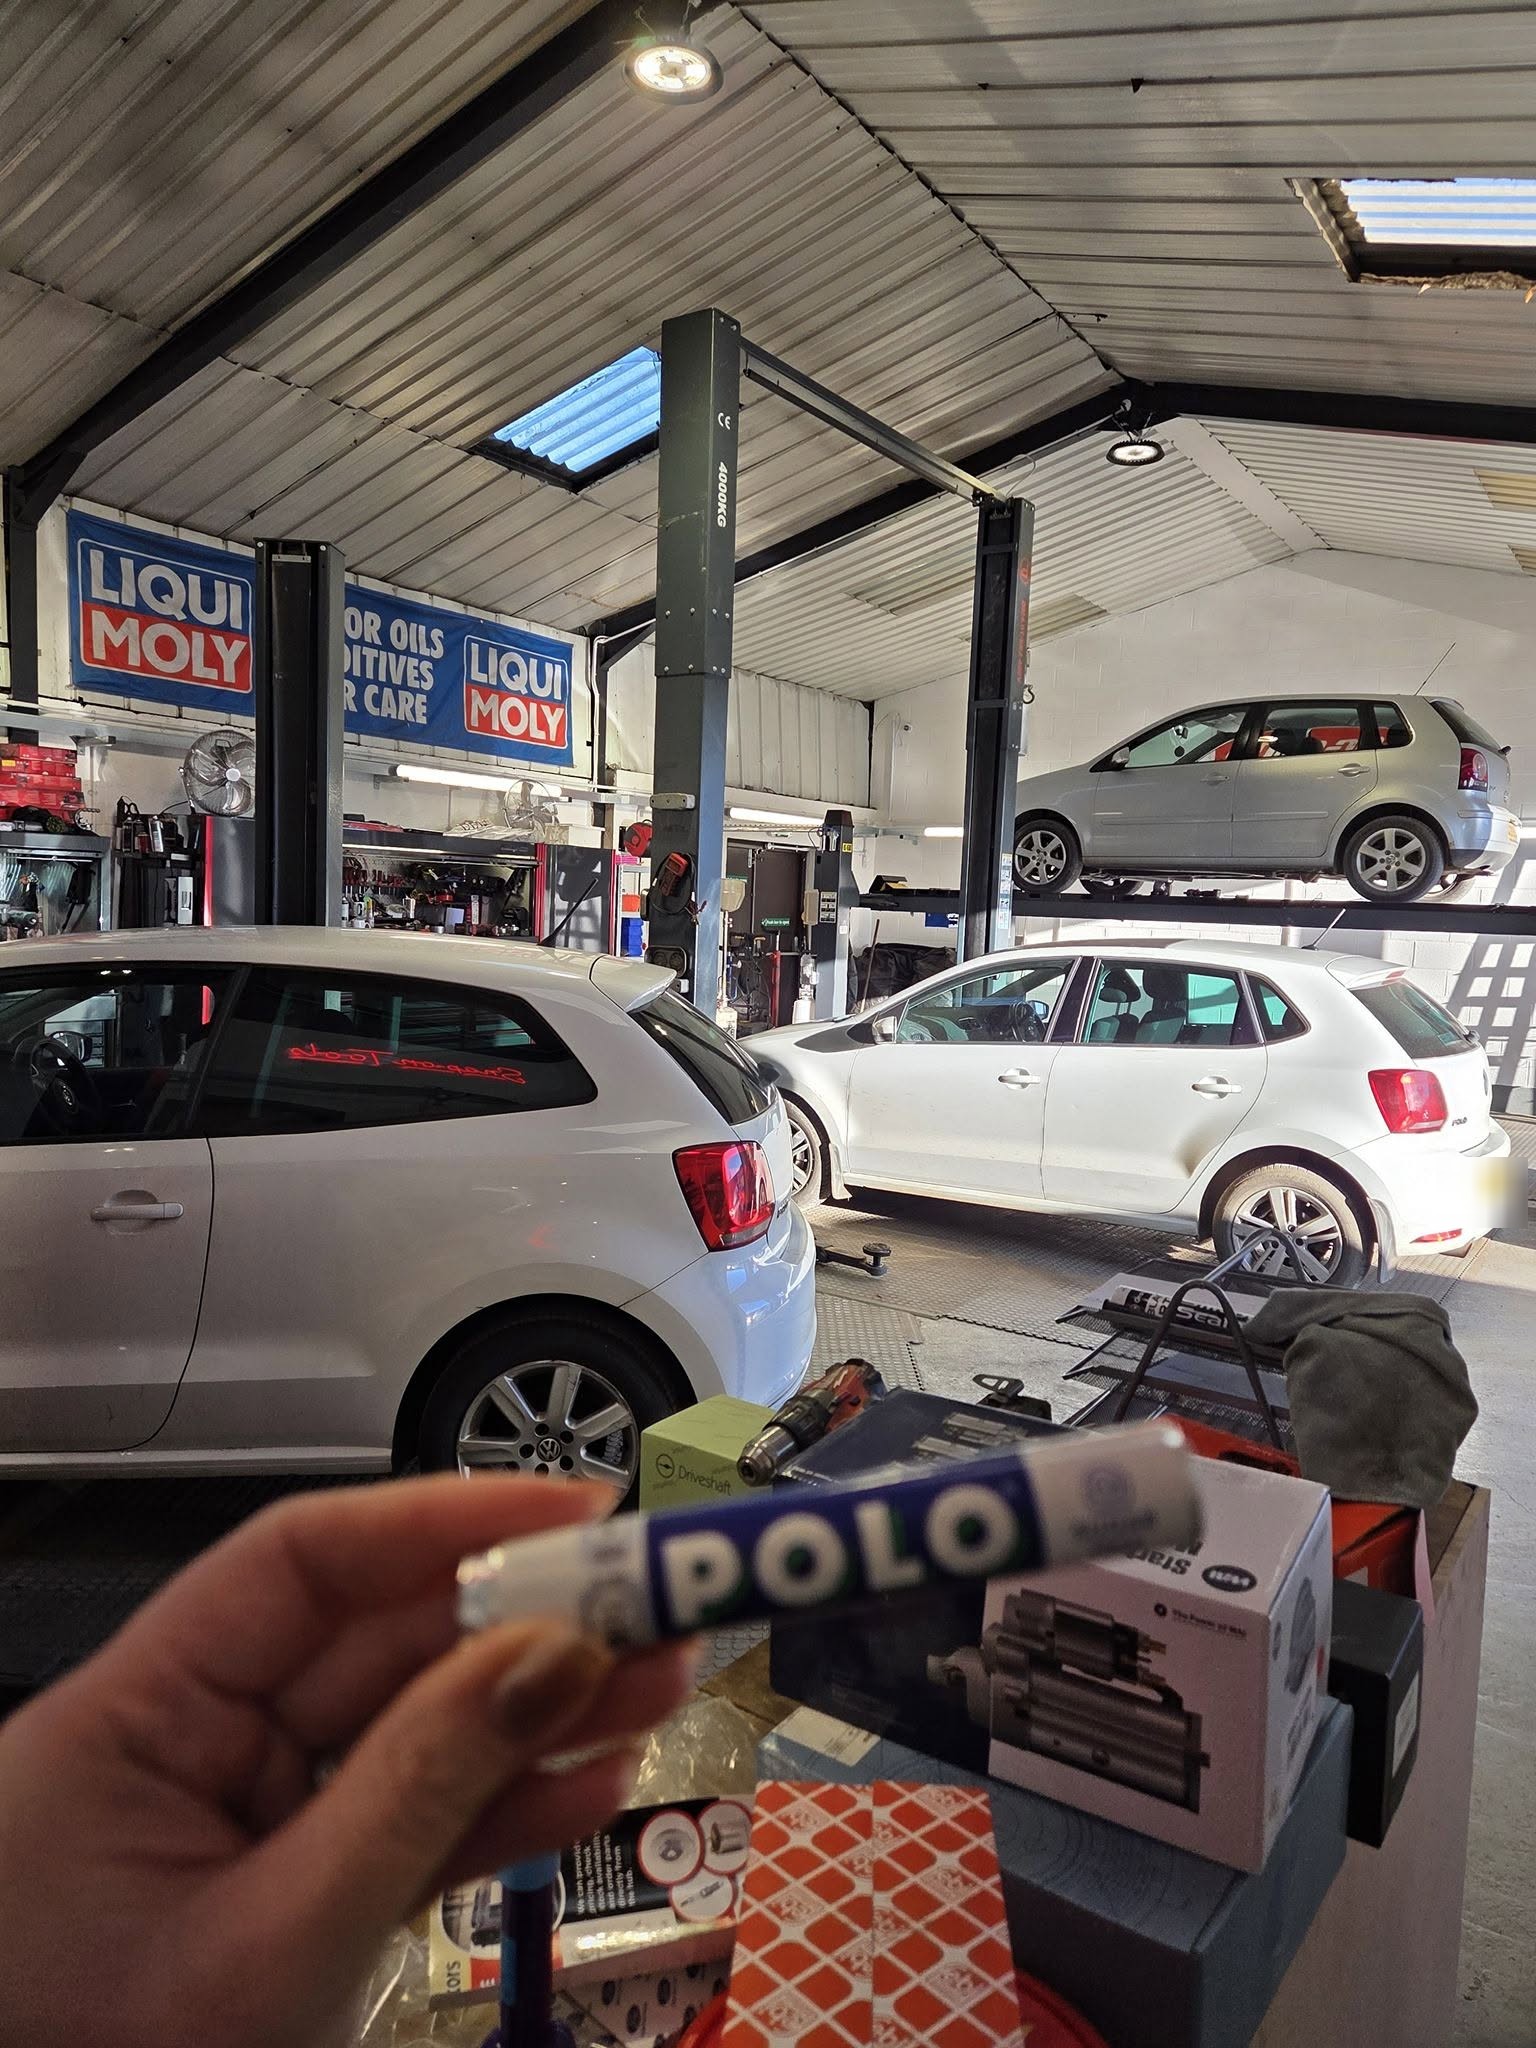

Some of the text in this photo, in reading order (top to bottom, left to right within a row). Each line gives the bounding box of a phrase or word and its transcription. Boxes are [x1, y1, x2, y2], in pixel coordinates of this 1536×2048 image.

[717, 461, 728, 528] 4000KG
[89, 549, 243, 630] LIQUI
[91, 610, 247, 683] MOLY
[390, 618, 444, 659] OILS
[344, 643, 434, 691] ITIVES
[470, 643, 562, 700] LIQUI
[363, 684, 427, 725] CARE
[470, 689, 565, 742] MOLY
[678, 1465, 732, 1496] Driveshaft
[661, 1483, 1018, 1629] POLO
[603, 1834, 612, 1862] parts
[614, 1845, 622, 1871] from
[605, 1864, 614, 1889] order
